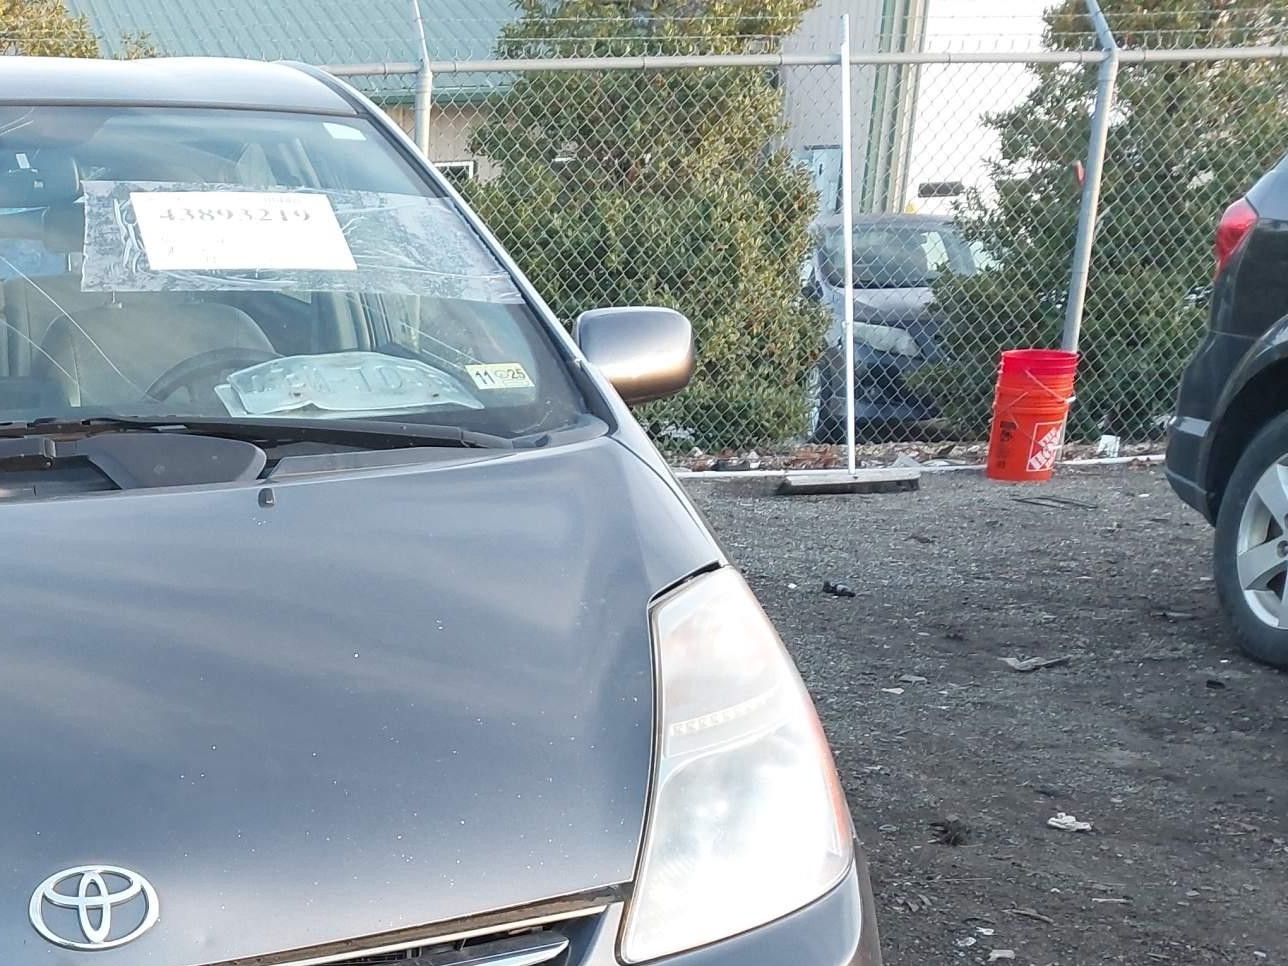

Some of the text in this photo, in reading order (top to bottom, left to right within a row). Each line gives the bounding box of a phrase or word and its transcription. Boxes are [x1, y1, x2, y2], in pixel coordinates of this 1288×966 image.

[159, 207, 314, 223] 43893219
[475, 368, 526, 385] 11 25
